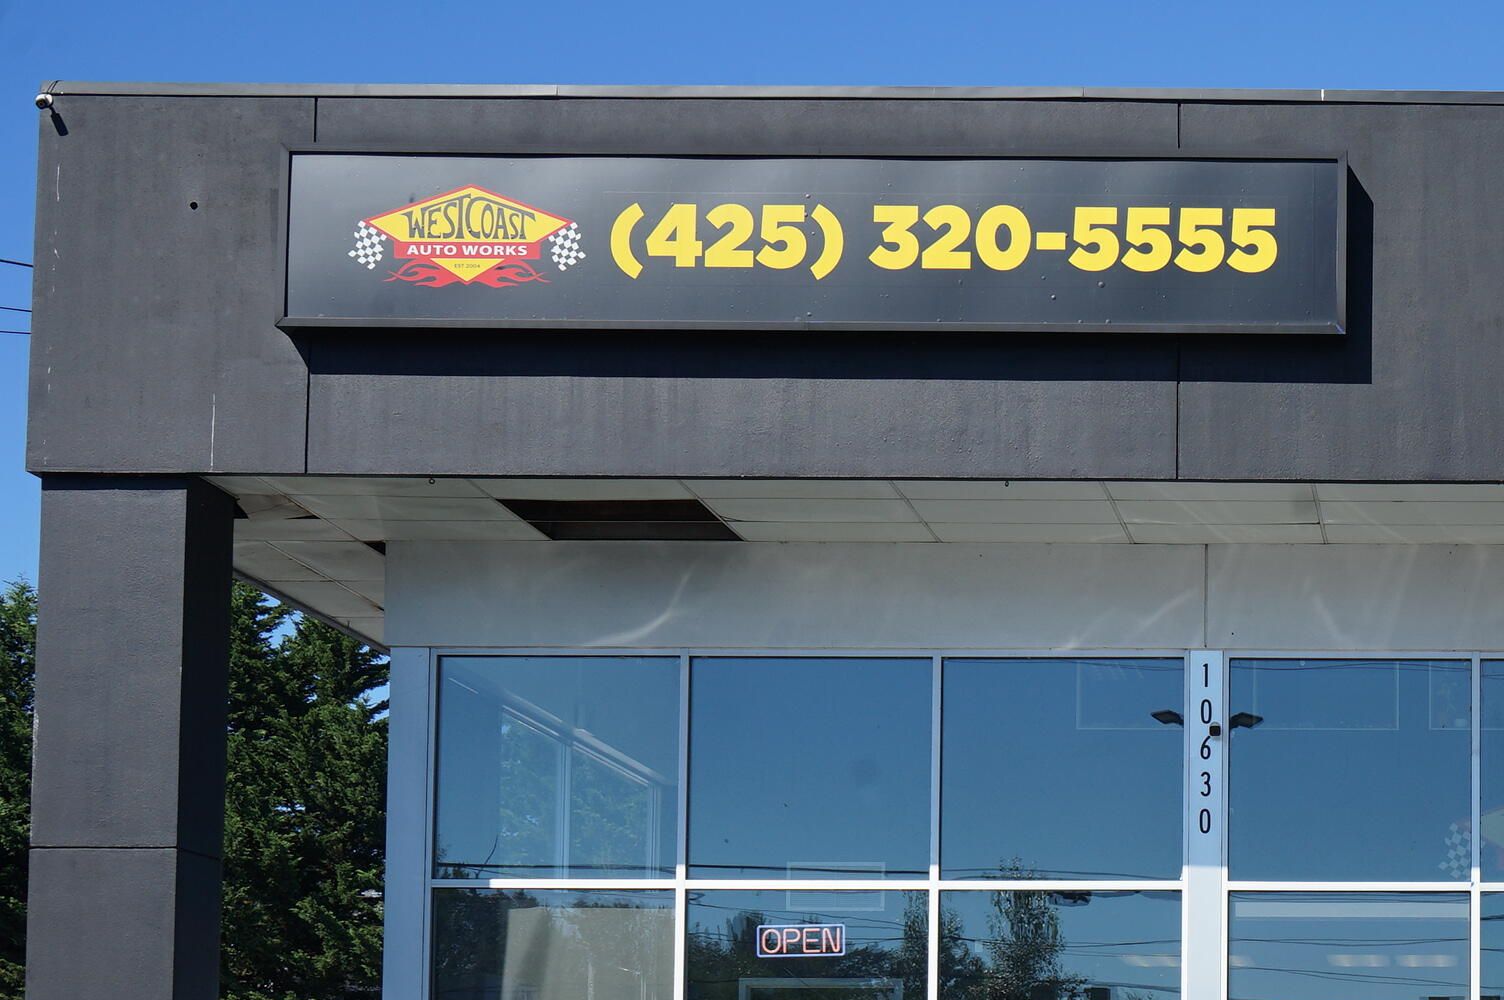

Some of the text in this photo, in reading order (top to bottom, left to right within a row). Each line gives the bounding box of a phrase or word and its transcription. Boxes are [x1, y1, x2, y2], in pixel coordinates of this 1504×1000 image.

[407, 245, 528, 256] AUTO WORKS
[611, 202, 1278, 280] (425) 320-5555
[1200, 663, 1212, 834] 10630
[762, 927, 840, 954] OPEN
